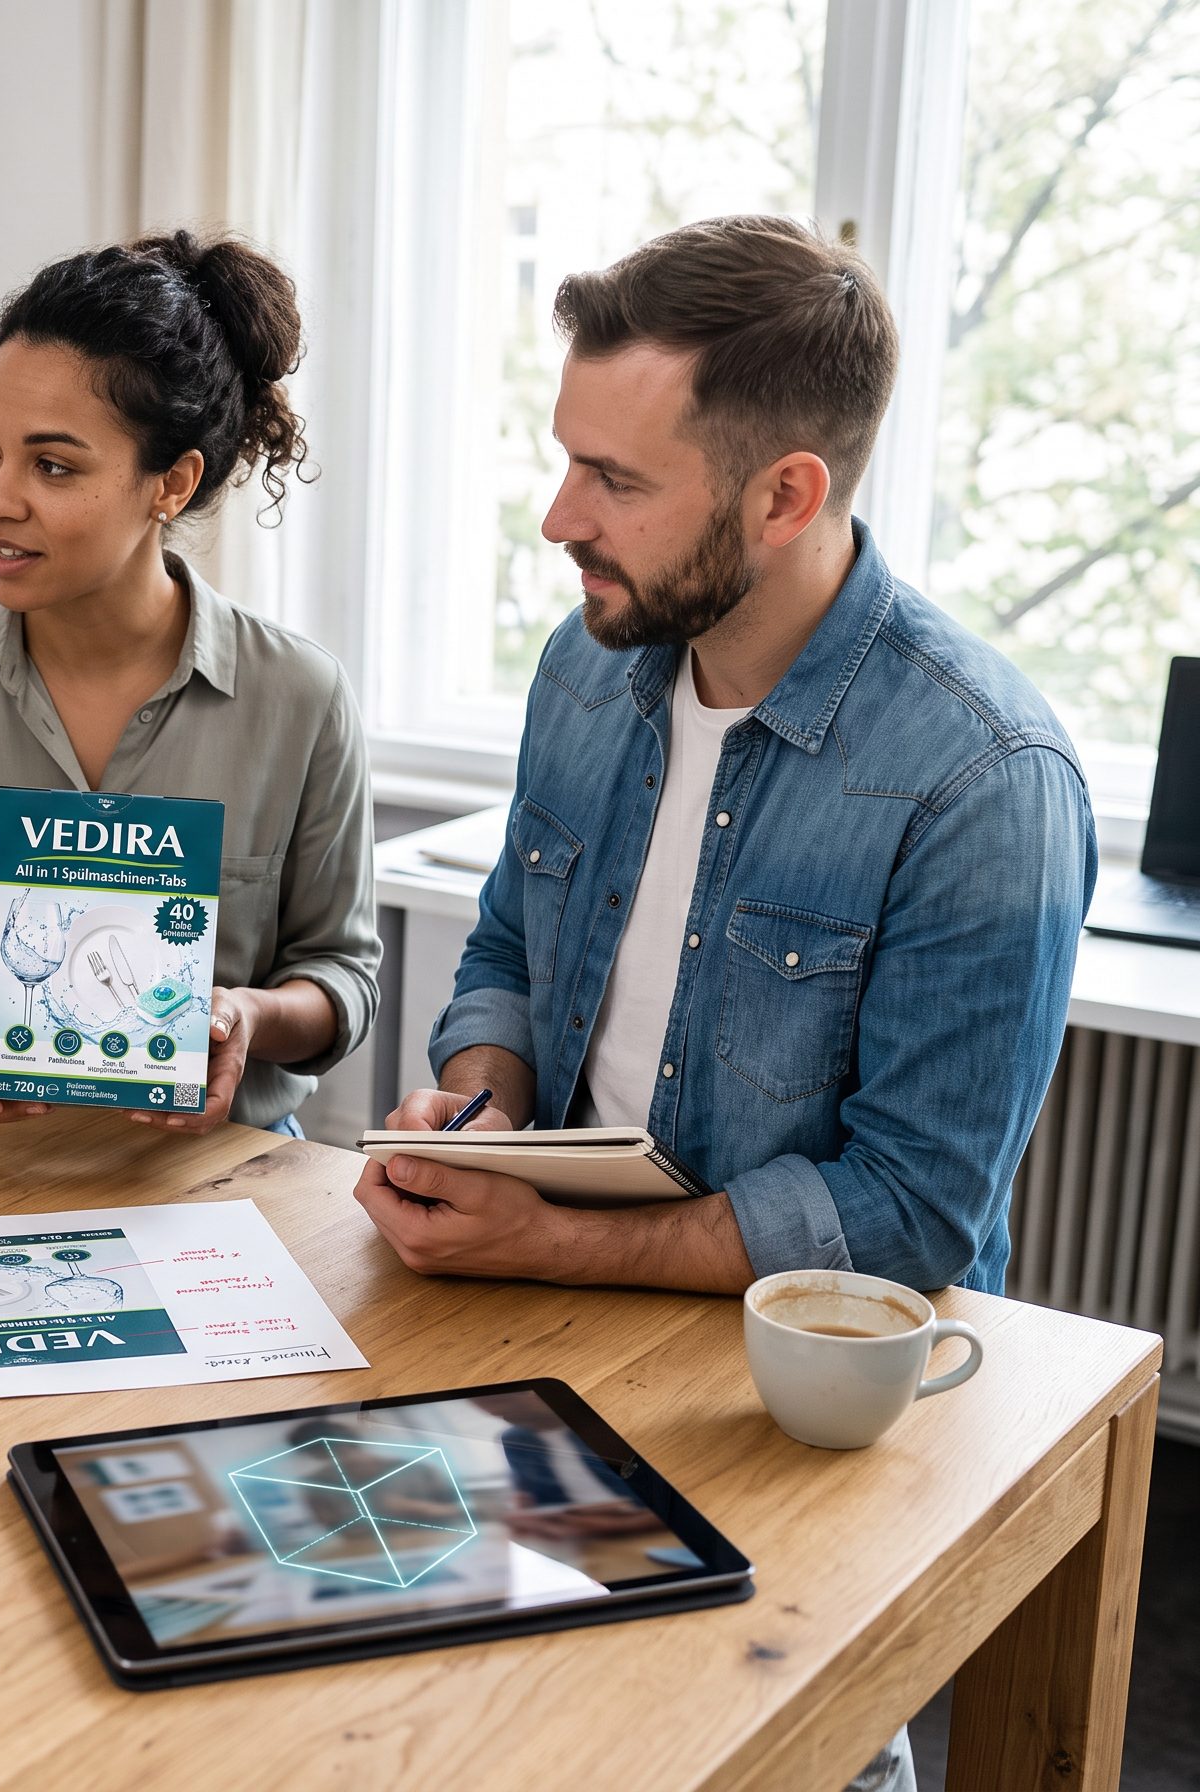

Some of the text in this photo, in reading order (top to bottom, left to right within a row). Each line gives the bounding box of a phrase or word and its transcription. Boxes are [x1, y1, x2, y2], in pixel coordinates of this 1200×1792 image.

[20, 816, 185, 859] VEDIRA
[15, 863, 187, 888] All in 1 Spülmaschinen-Tabs
[169, 903, 194, 921] 40
[14, 1080, 35, 1093] 720
[37, 1084, 45, 1098] g
